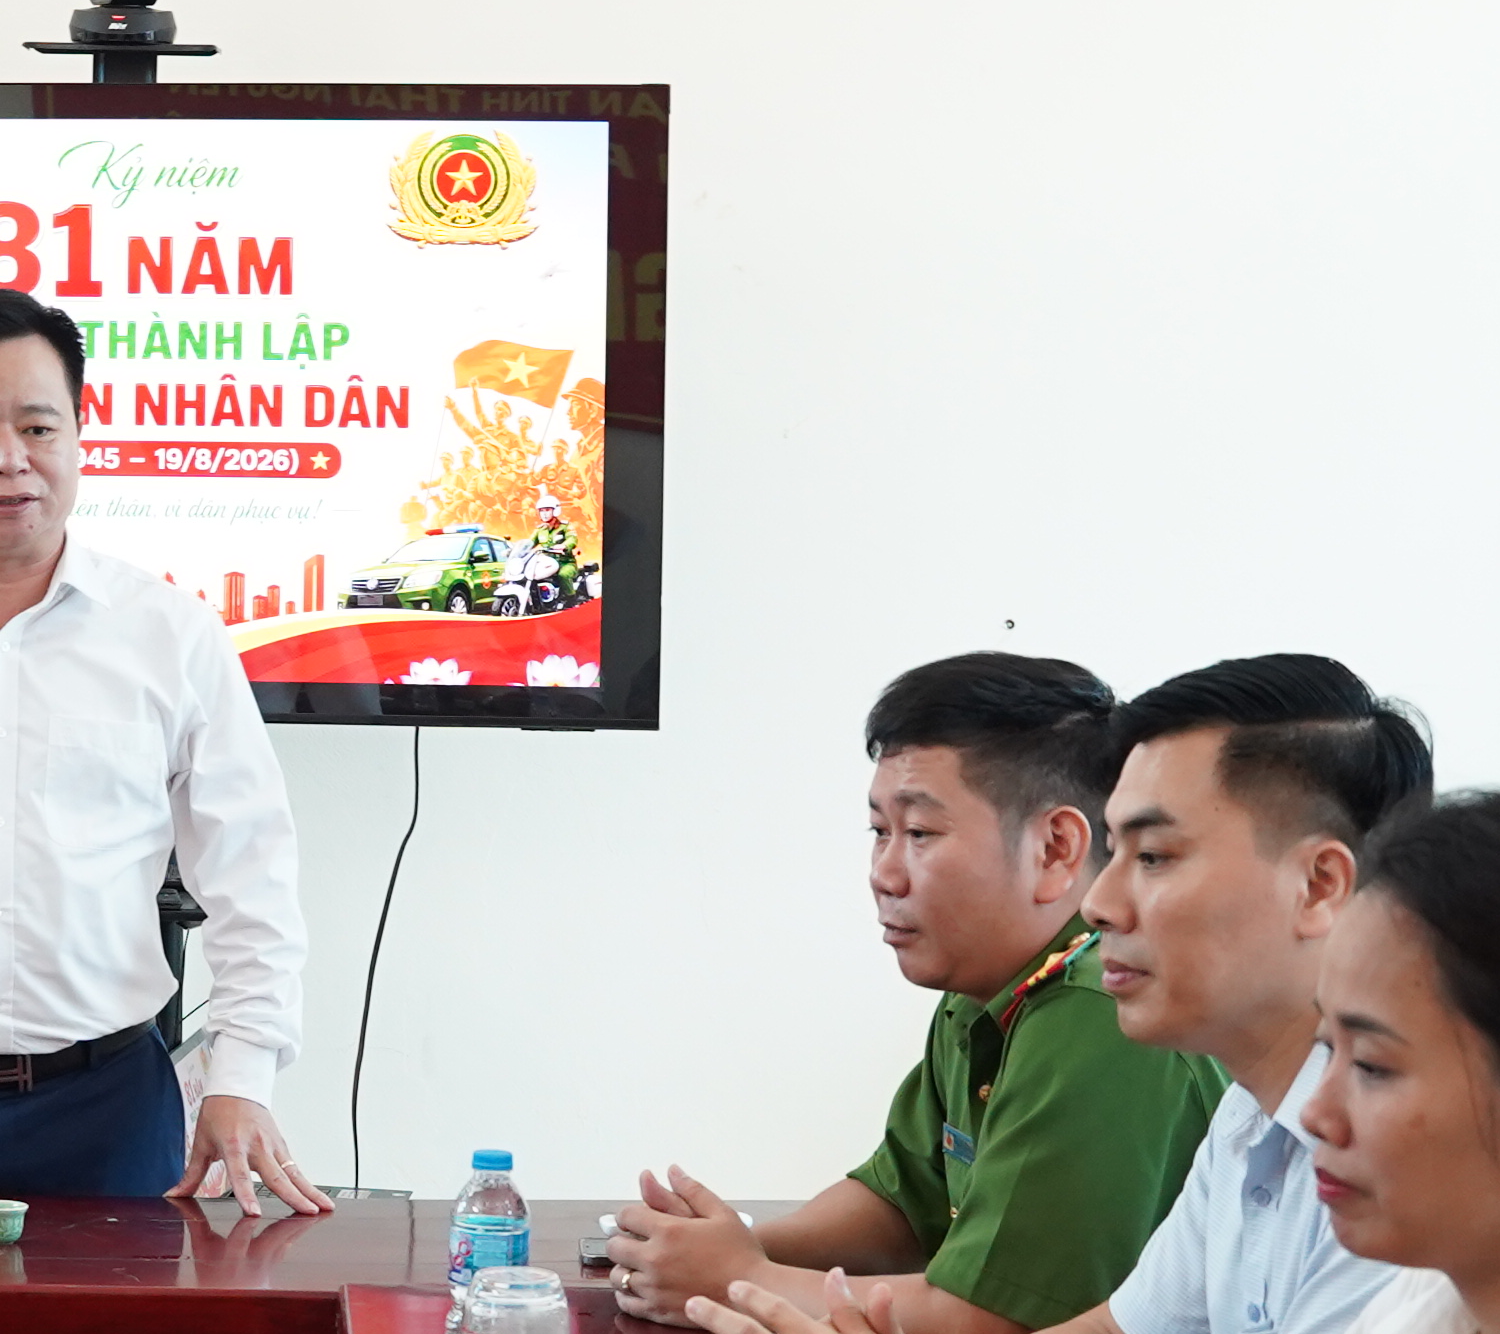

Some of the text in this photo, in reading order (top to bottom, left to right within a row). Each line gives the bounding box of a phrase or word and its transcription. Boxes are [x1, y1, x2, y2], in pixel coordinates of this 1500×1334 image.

[58, 140, 242, 208] Kỷ niệm
[127, 221, 294, 295] NĂM
[78, 311, 350, 369] THÀNH LẬP
[134, 374, 286, 427] NHÂN
[304, 375, 411, 429] DÂN
[154, 447, 300, 475] 19/8/2026)
[230, 498, 283, 525] phục
